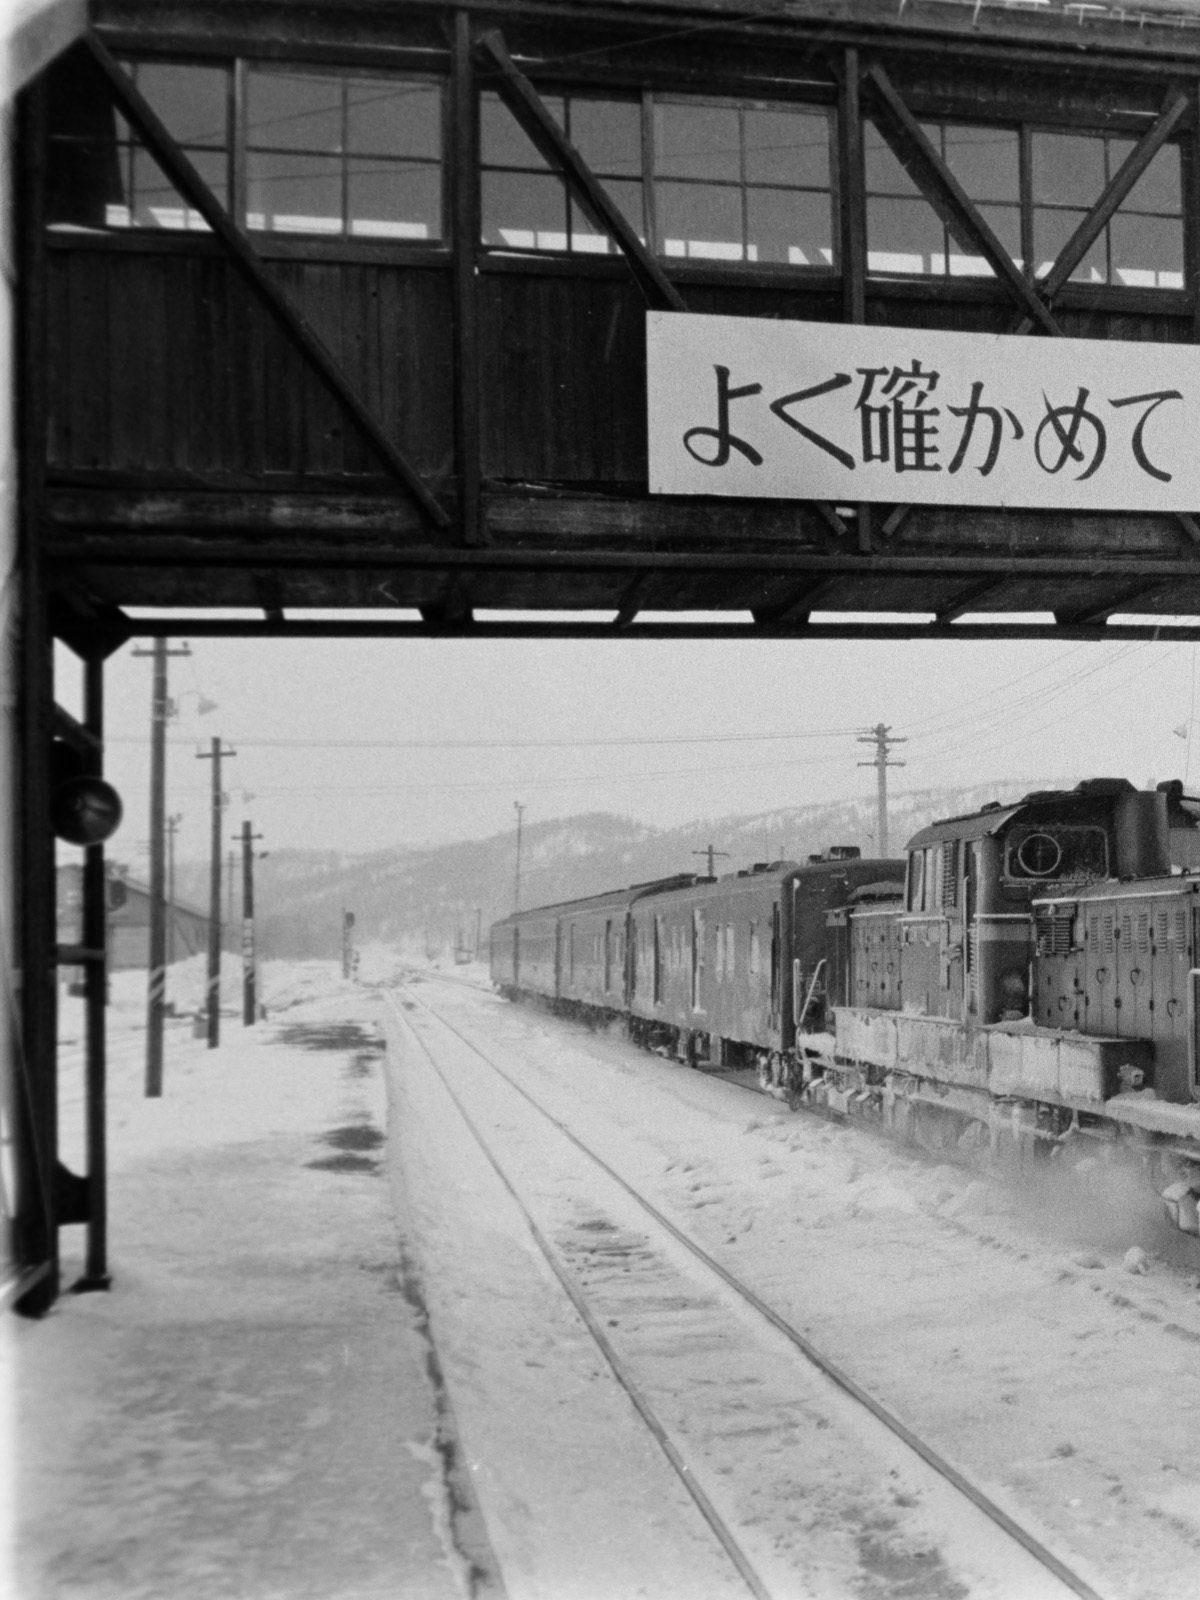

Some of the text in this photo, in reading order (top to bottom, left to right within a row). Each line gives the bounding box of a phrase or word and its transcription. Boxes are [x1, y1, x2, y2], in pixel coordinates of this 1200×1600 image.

[682, 359, 1185, 483] よく確かめて
